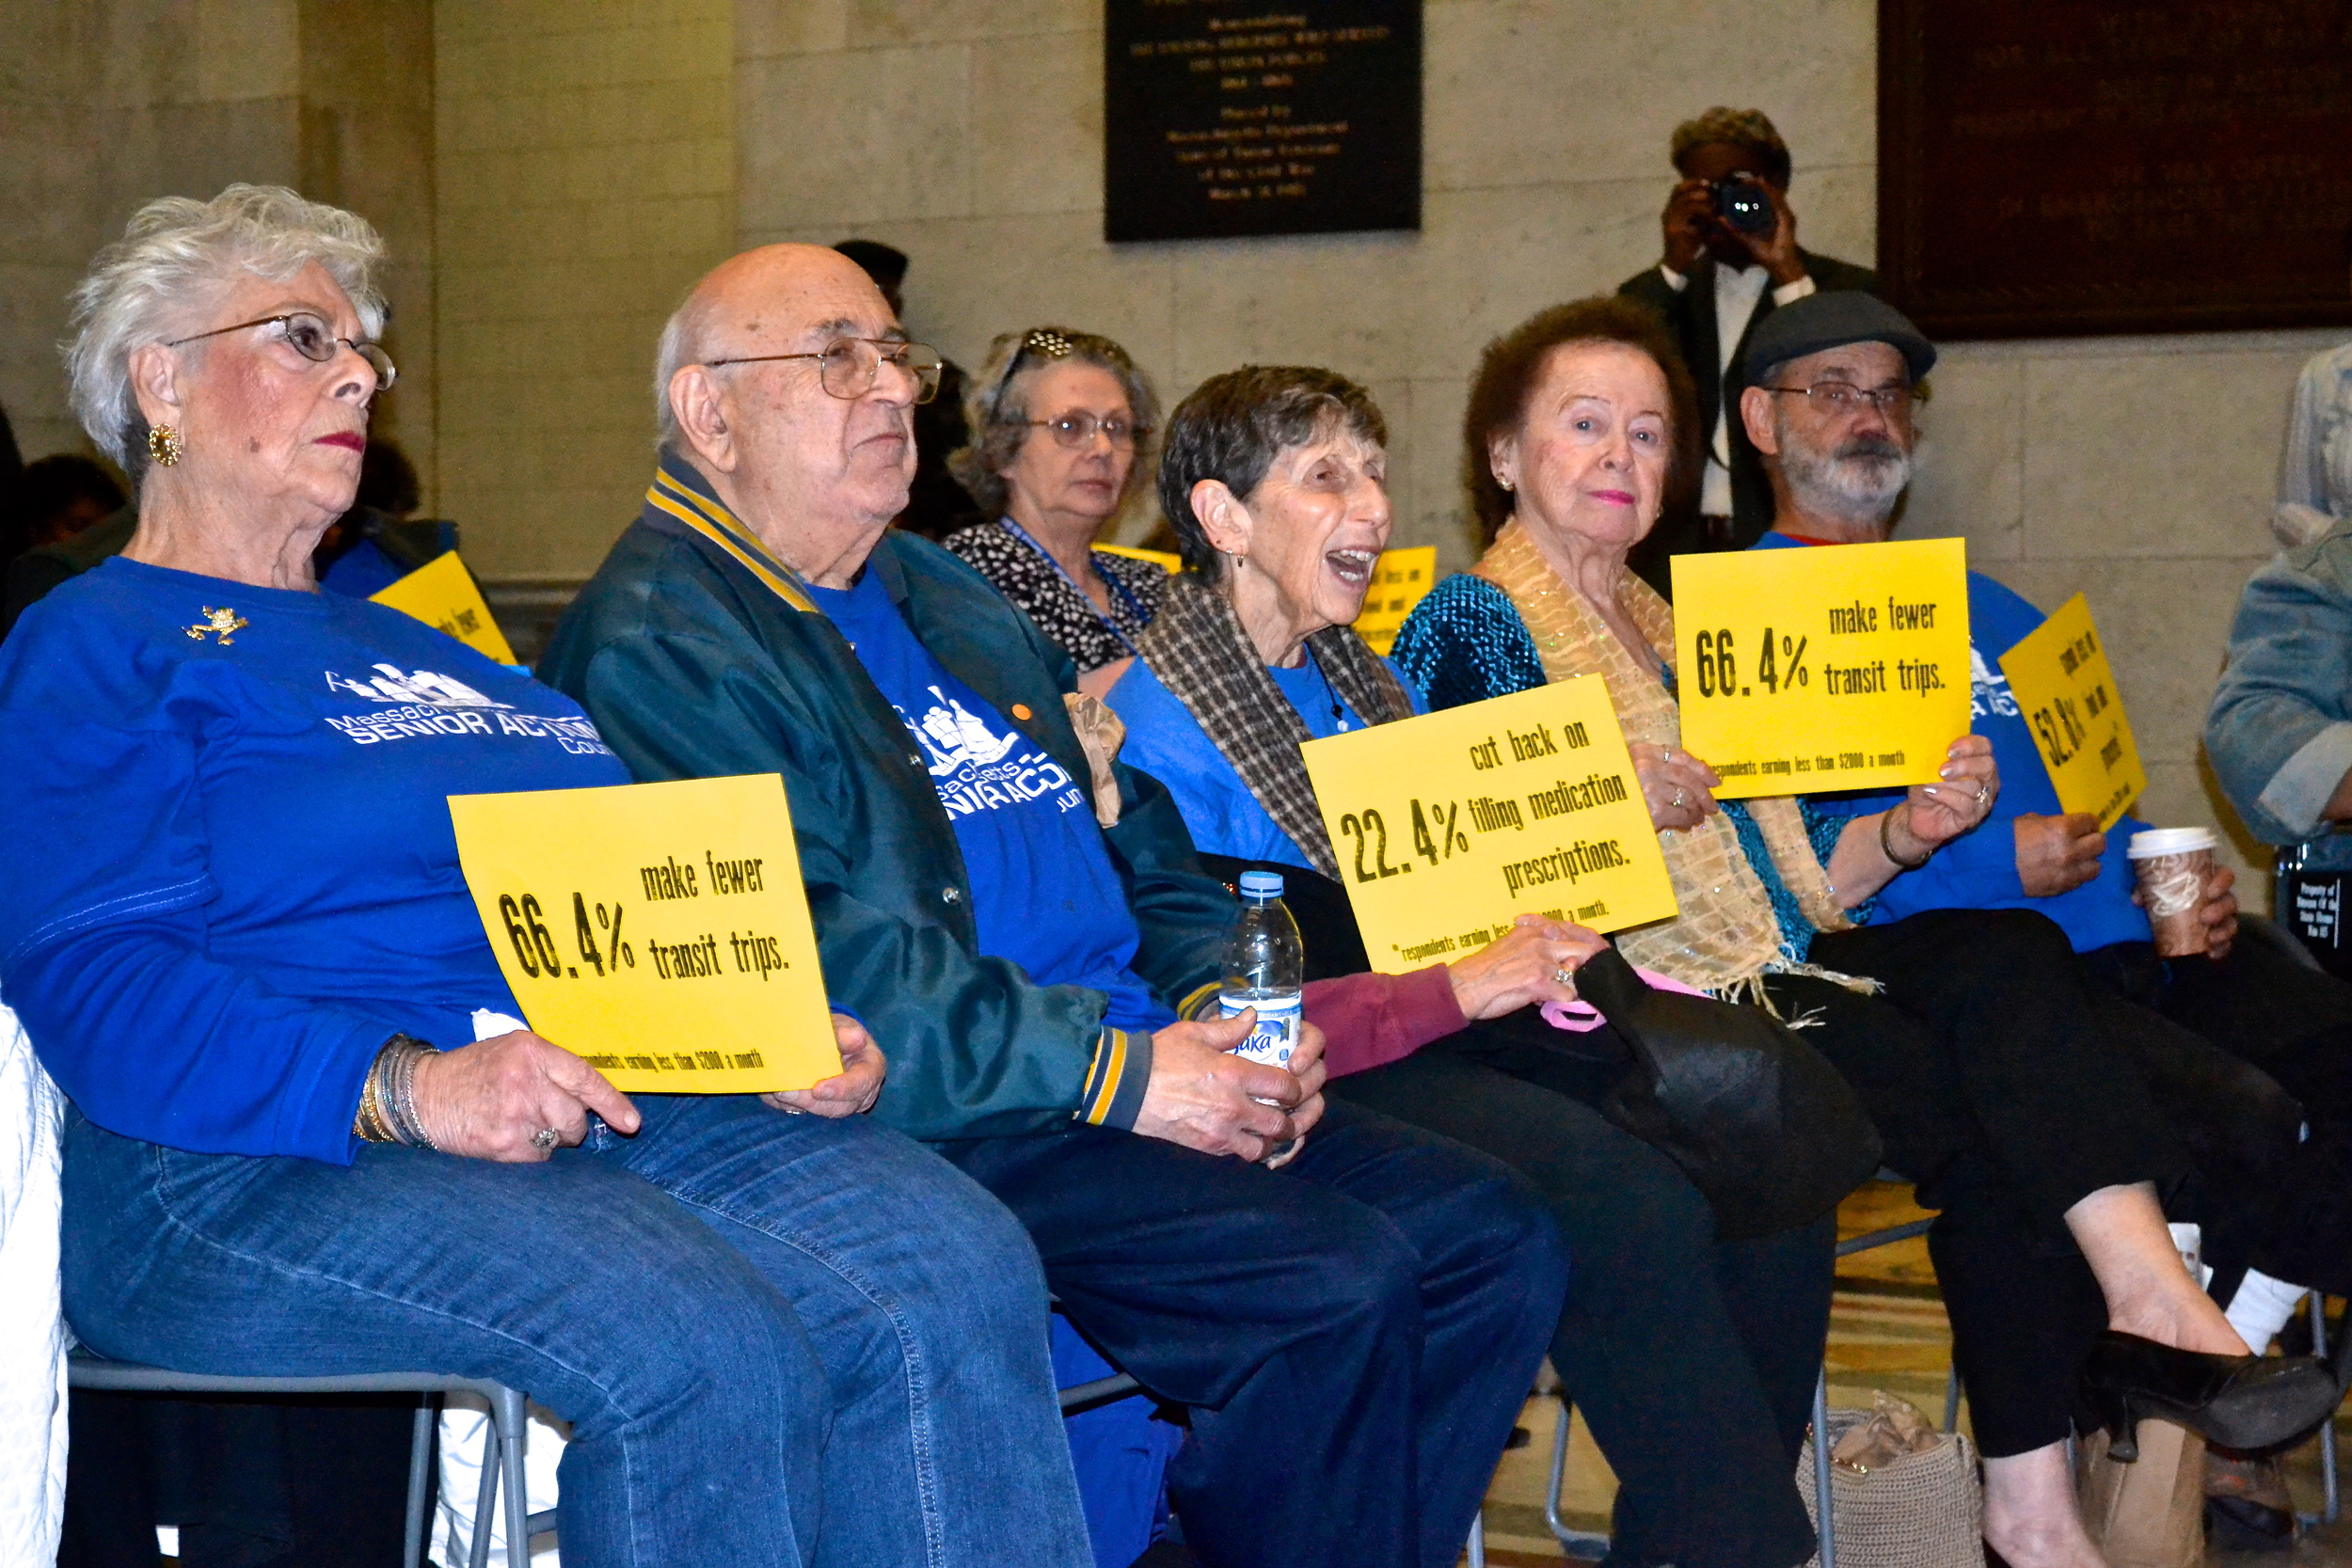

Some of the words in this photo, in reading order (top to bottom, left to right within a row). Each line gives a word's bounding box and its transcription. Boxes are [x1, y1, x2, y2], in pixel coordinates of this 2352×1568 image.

[1829, 600, 1877, 634] make
[1888, 596, 1936, 630] fewer
[1696, 628, 1807, 698] 66.4%
[1824, 660, 1885, 695] transit
[1898, 659, 1945, 697] trips.
[343, 711, 492, 744] SENIOR
[1470, 736, 1502, 769] cut
[1507, 723, 1558, 762] back
[1565, 721, 1589, 749] on
[1761, 761, 1790, 775] earning
[1795, 756, 1810, 771] less
[1816, 756, 1834, 769] than
[1839, 752, 1864, 768] $2000
[1869, 755, 1873, 767] a
[1878, 751, 1904, 767] month
[1468, 798, 1523, 832] filling
[1528, 774, 1628, 819] medication
[1340, 799, 1469, 884] 22.4%
[641, 856, 698, 901] make
[707, 850, 763, 895] fewer
[1502, 840, 1629, 898] prescriptions.
[499, 893, 635, 979] 66.4%
[1459, 928, 1491, 948] earning
[1568, 911, 1575, 923] a
[649, 934, 722, 979] transit
[730, 931, 788, 981] trips.
[625, 1054, 658, 1072] earning
[654, 1053, 675, 1069] less
[674, 1053, 696, 1069] than
[695, 1051, 723, 1069] $2000
[725, 1054, 734, 1069] a
[734, 1049, 764, 1069] month
